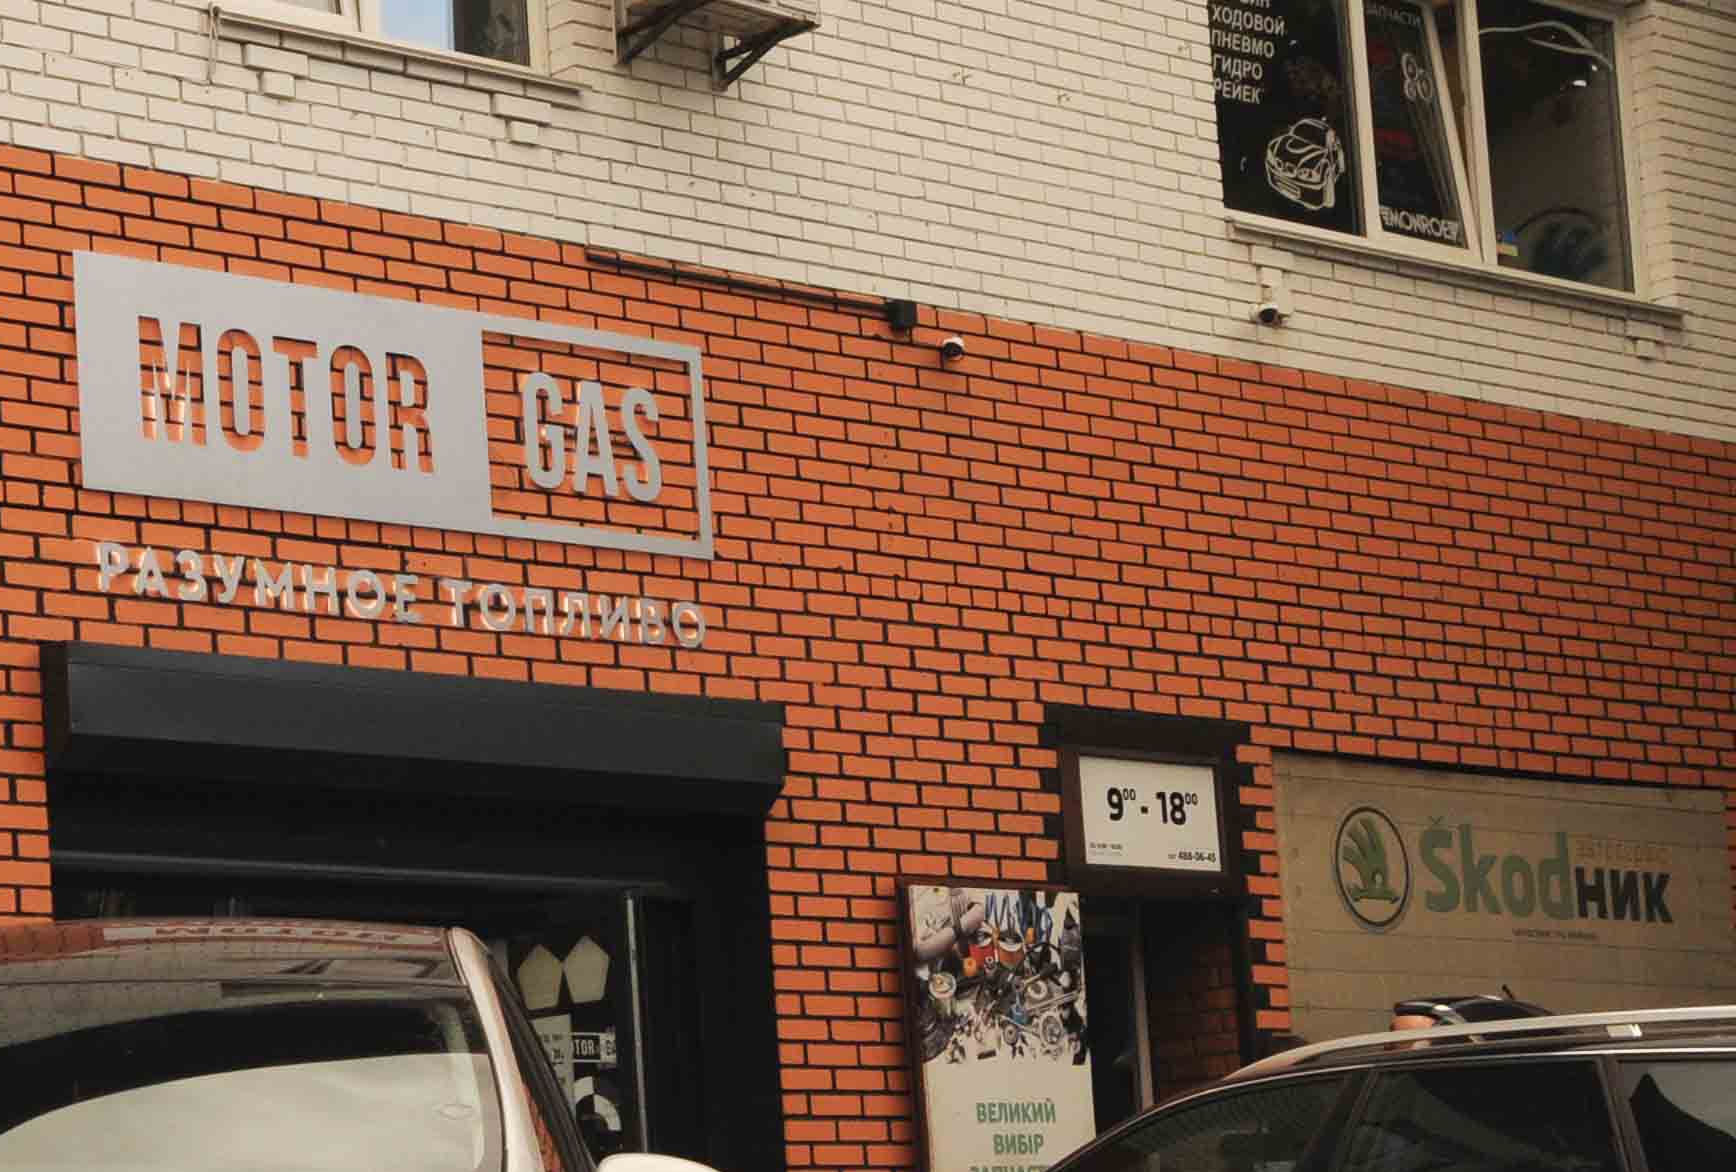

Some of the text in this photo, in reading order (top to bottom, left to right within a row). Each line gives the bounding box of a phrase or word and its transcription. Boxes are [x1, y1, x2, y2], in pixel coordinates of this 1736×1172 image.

[1212, 4, 1285, 36] ХОДОВОЙ
[1211, 29, 1274, 59] ПНЕВМО
[1213, 53, 1263, 80] ГИДРО
[1214, 78, 1260, 104] РЕЙЕК
[137, 315, 663, 502] MOTOR GAS
[96, 541, 707, 649] РАЗУМНОЕ ТОПЛИВО
[976, 1098, 1057, 1124] ВЕЛИКИЙ
[993, 1133, 1045, 1156] ВИБІР
